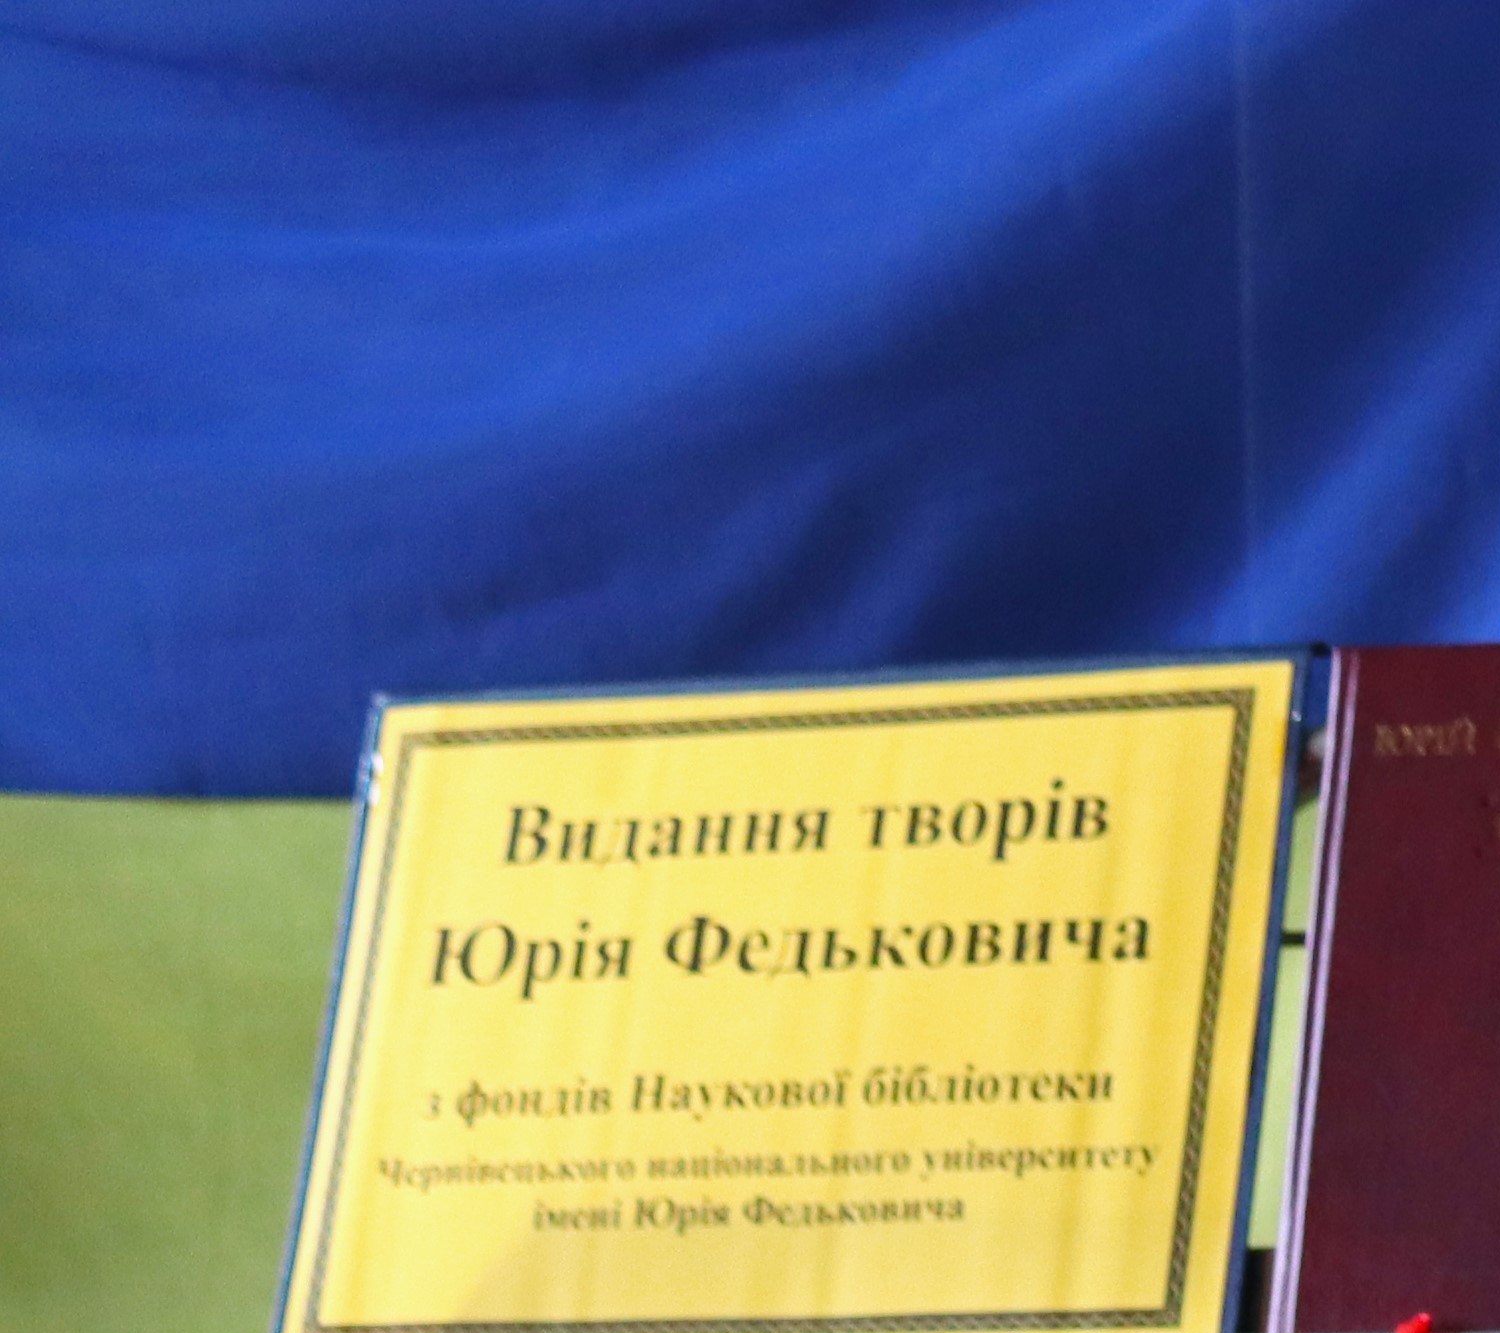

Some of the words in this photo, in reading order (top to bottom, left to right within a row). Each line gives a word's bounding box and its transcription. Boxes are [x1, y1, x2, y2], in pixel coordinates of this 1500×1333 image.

[502, 805, 831, 867] Видання
[864, 778, 1110, 863] творів
[430, 919, 633, 1001] Юрія
[664, 913, 1150, 979] Федьковича
[425, 1093, 441, 1118] з
[456, 1073, 613, 1128] фондів
[631, 1069, 850, 1121] Наукової
[861, 1064, 1113, 1104] бібліотеки
[378, 1155, 636, 1192] Чернівецького
[647, 1149, 911, 1182] національного
[921, 1141, 1155, 1180] університету
[533, 1201, 621, 1233] імені
[635, 1197, 730, 1236] Юрія
[741, 1196, 965, 1232] Федьковича
